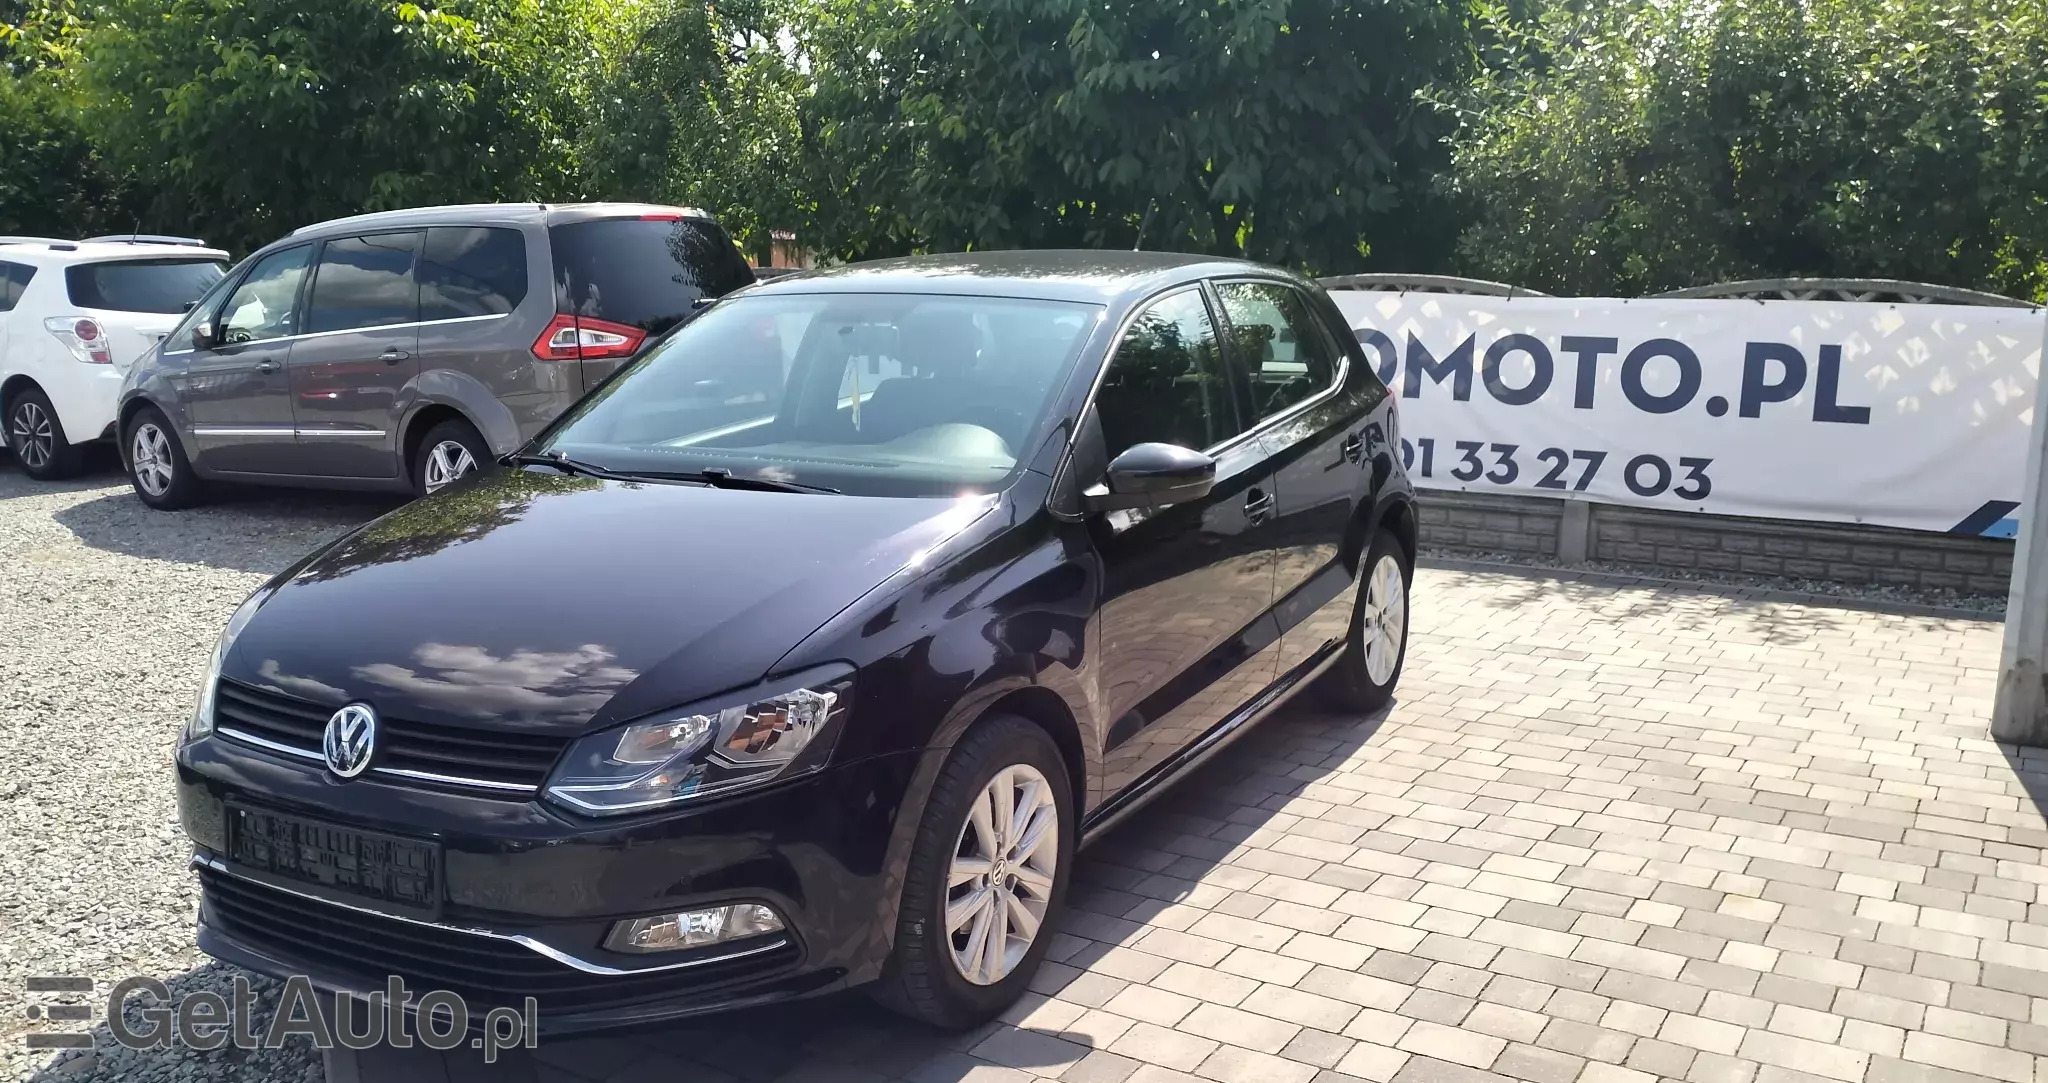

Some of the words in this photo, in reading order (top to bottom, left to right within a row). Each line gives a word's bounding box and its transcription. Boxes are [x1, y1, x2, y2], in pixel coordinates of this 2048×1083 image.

[1401, 438, 1435, 479] 1
[1450, 441, 1520, 485] 33
[1534, 448, 1608, 492] 27
[1624, 454, 1714, 501] 03
